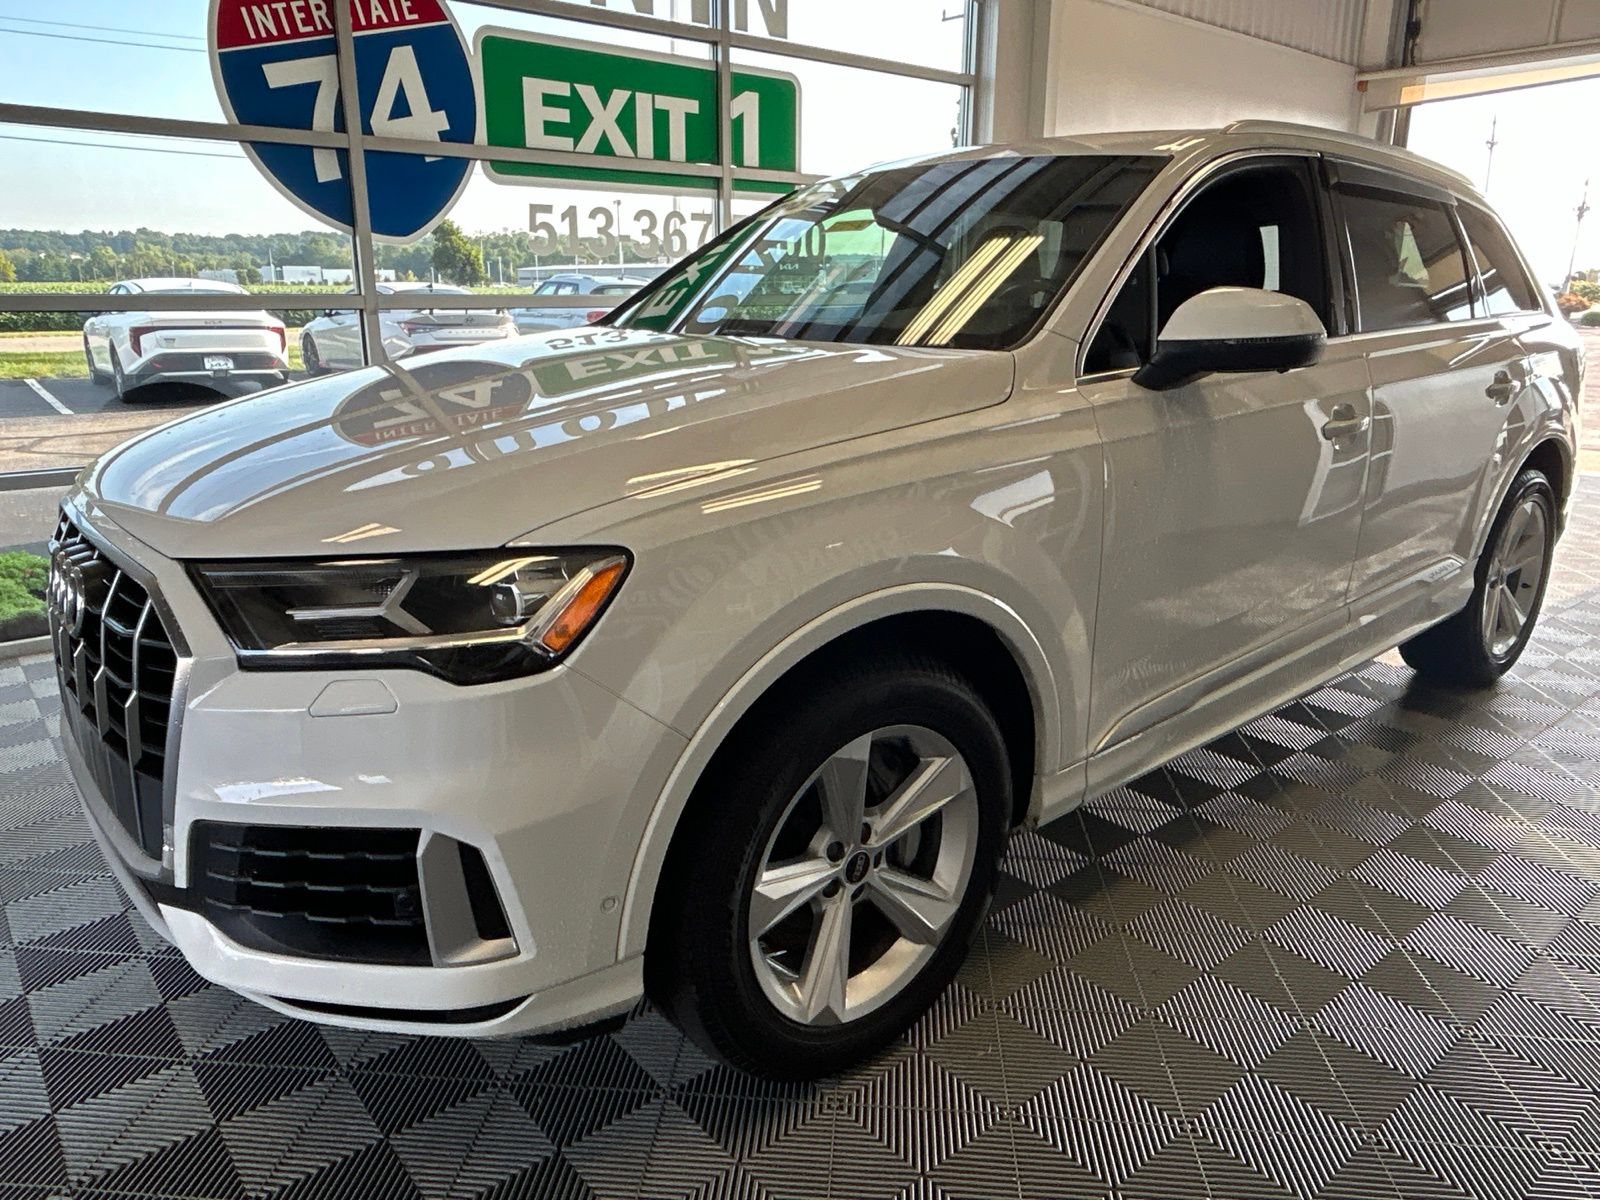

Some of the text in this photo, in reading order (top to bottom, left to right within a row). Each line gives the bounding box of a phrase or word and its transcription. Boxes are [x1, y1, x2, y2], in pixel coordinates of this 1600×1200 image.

[239, 0, 419, 39] INTERTATE
[261, 45, 451, 184] 74
[521, 75, 761, 168] EXIT 1
